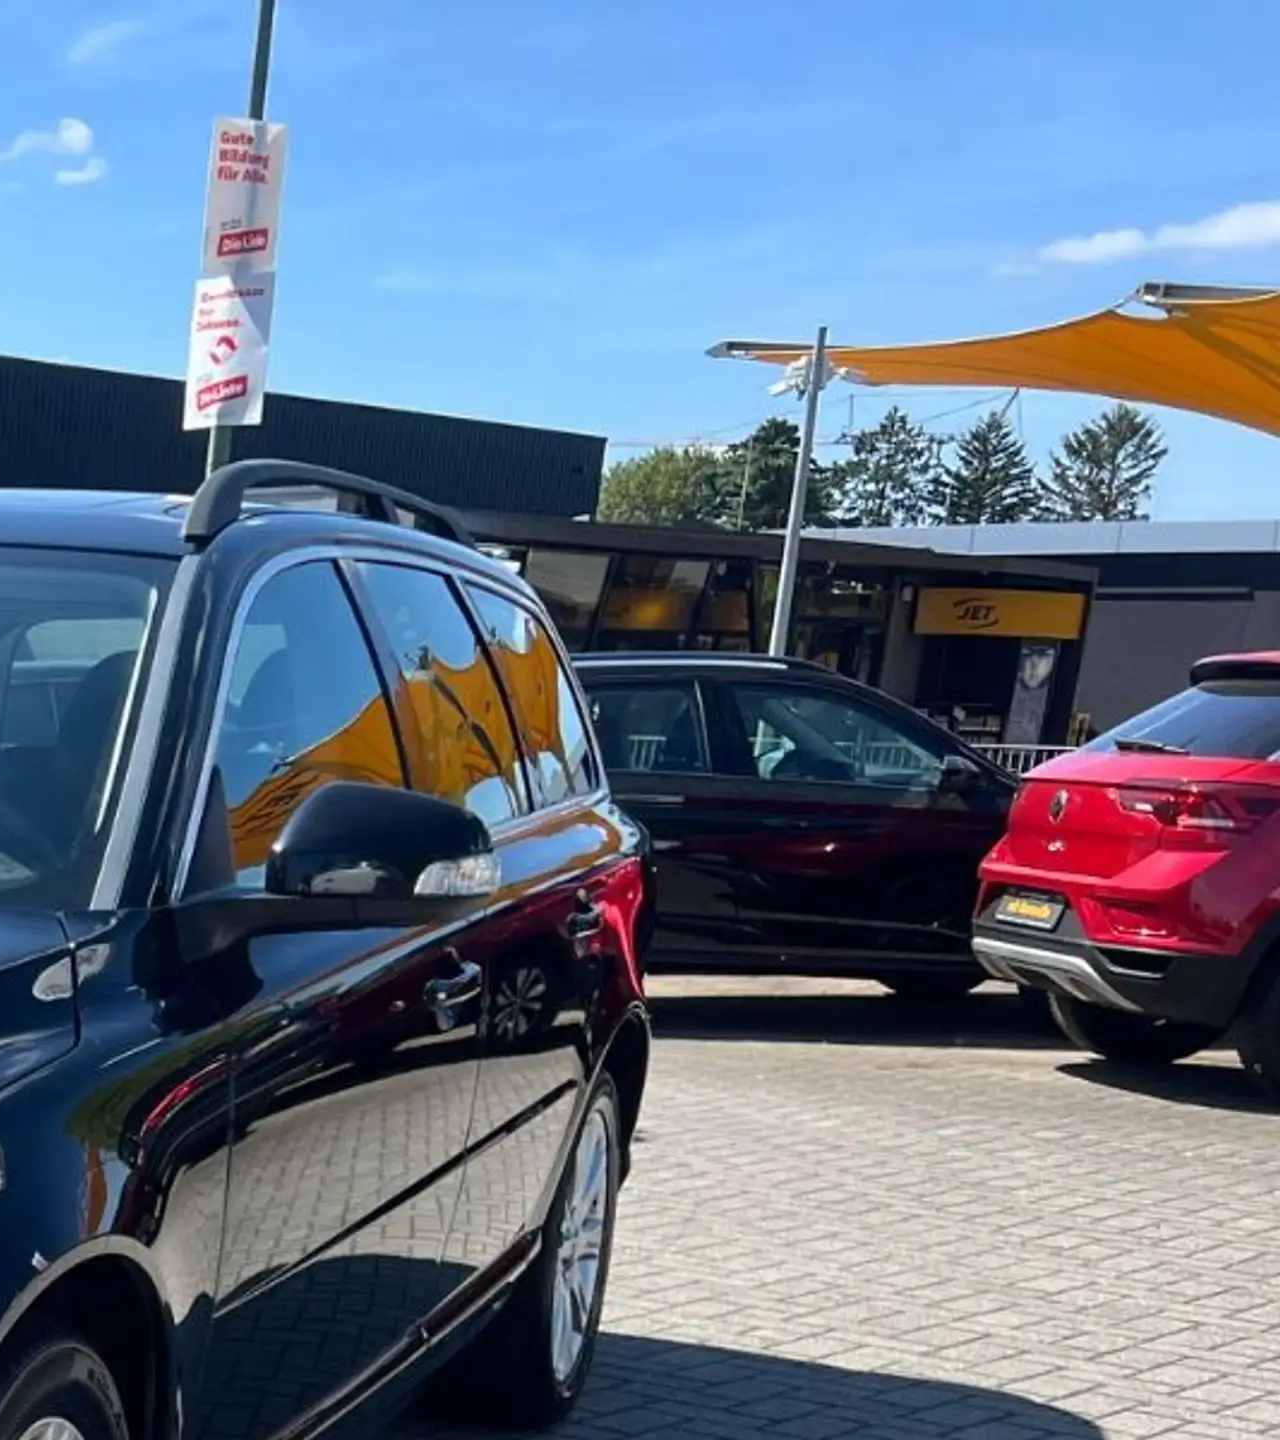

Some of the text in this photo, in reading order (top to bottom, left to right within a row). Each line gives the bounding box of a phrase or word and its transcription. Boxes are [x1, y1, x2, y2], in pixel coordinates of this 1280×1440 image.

[221, 130, 254, 145] Gute
[219, 148, 269, 170] Bildung
[956, 604, 997, 621] JET
